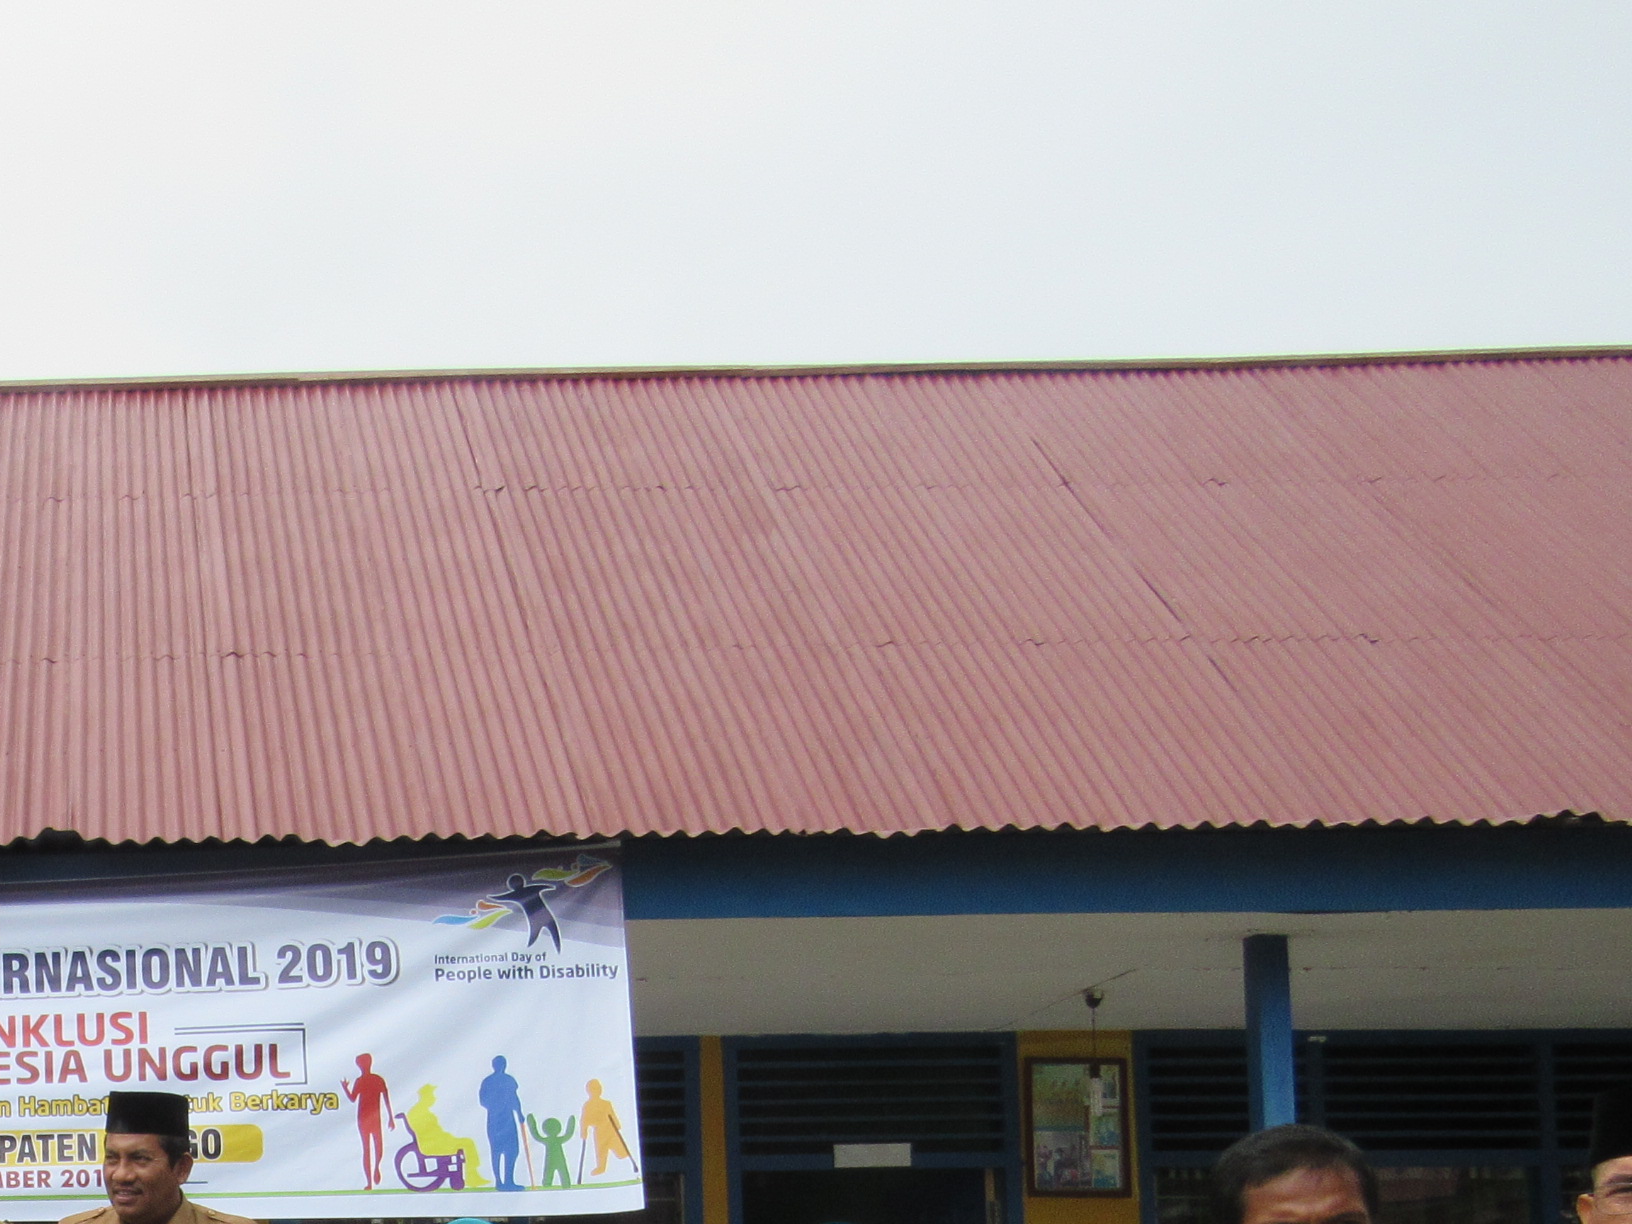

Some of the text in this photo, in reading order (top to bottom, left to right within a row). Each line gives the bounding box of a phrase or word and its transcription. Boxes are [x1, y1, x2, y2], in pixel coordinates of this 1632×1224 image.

[276, 939, 393, 984] 2019
[434, 951, 547, 965] International Day of
[435, 963, 619, 983] People with Disability
[104, 1043, 291, 1082] UNGGUL
[229, 1089, 340, 1115] Berkarya
[60, 1168, 102, 1188] 201
